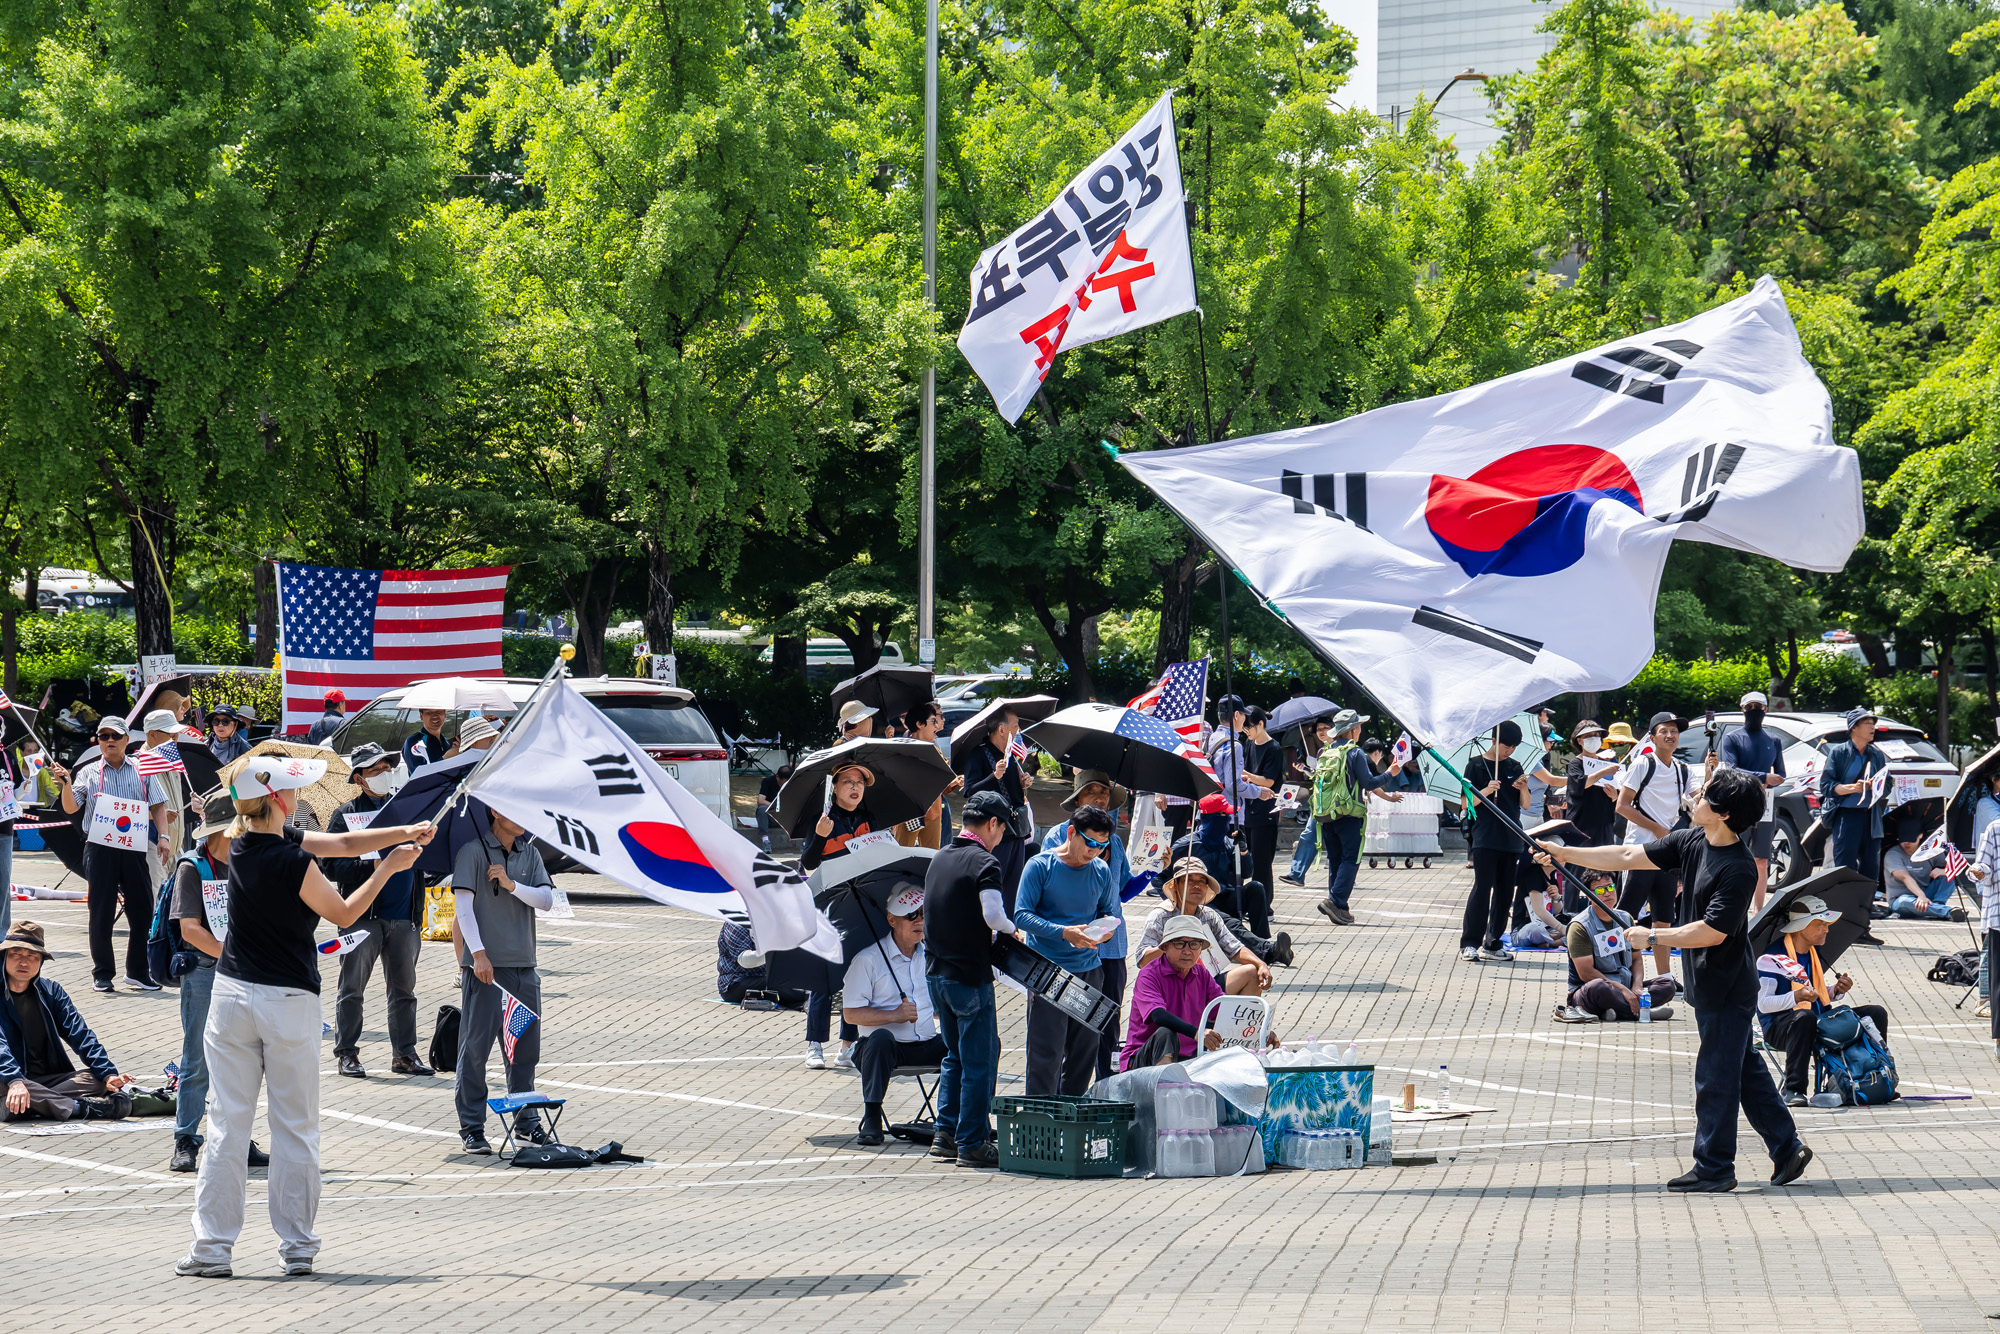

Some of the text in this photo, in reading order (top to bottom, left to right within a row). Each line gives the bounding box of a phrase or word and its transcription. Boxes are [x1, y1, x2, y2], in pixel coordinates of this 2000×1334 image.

[433, 930, 453, 938] SAV
[1062, 995, 1087, 1014] HAPPINESS
[1067, 987, 1092, 1007] DELIVERING
